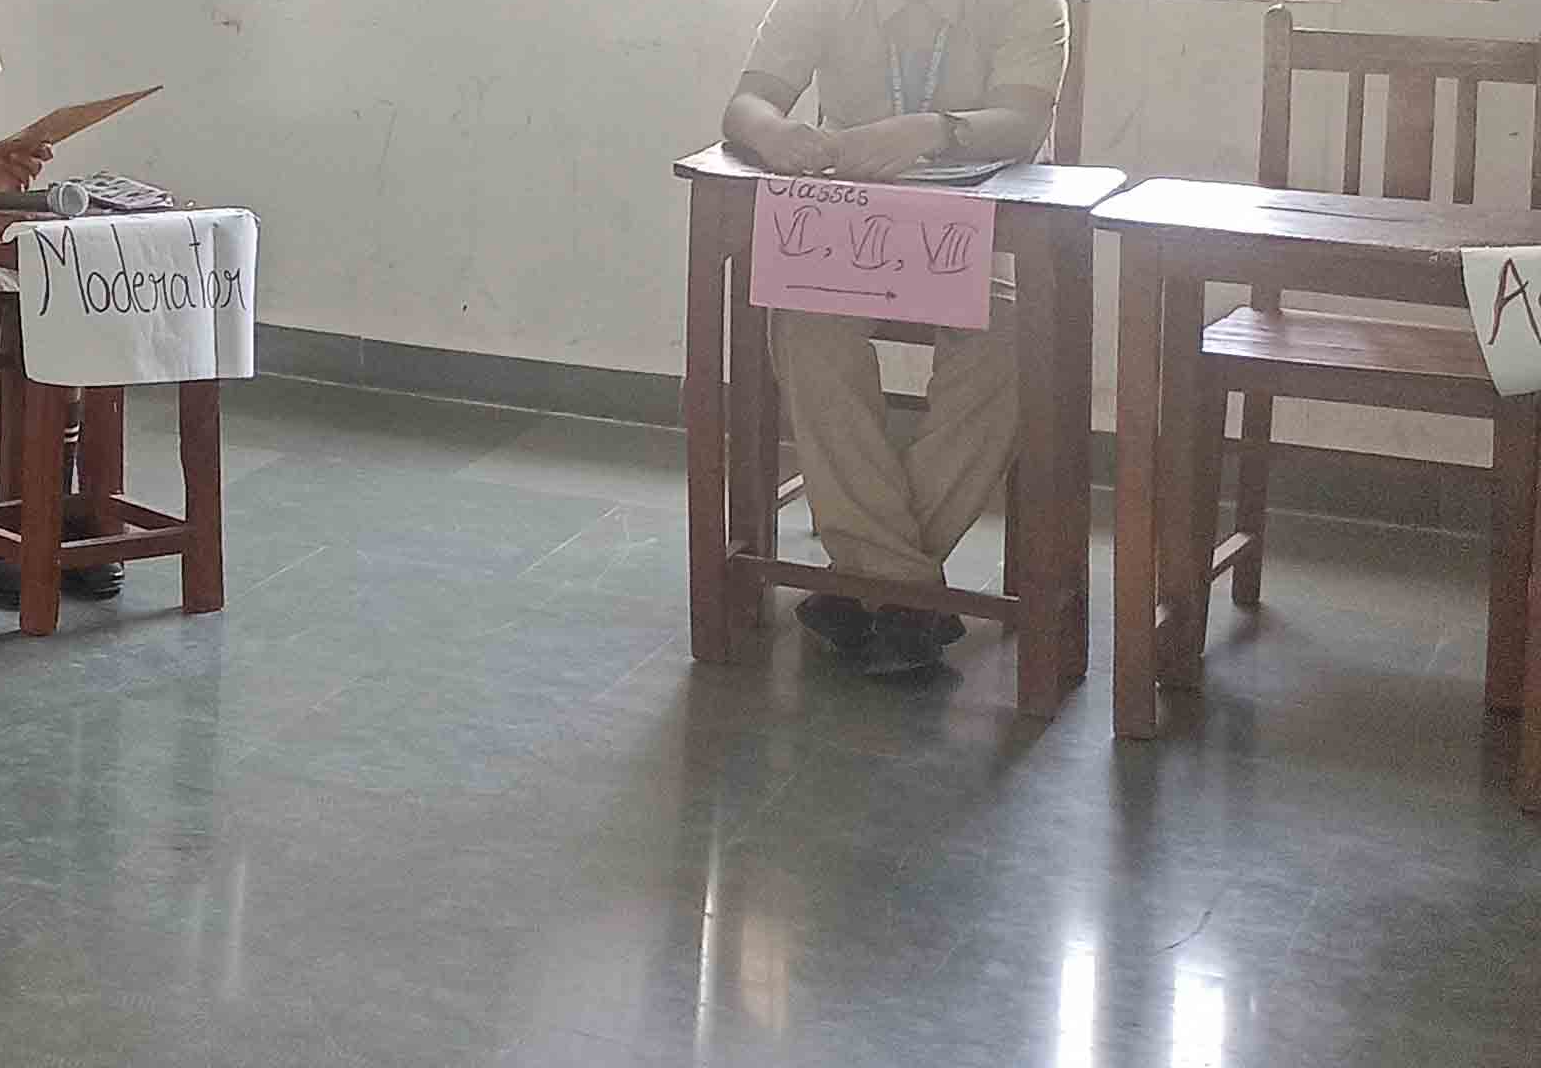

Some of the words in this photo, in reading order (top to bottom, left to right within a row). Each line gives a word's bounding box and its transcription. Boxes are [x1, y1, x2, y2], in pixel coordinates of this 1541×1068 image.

[32, 217, 247, 316] Moderator
[920, 222, 979, 274] VIII
[1487, 257, 1541, 346] A
